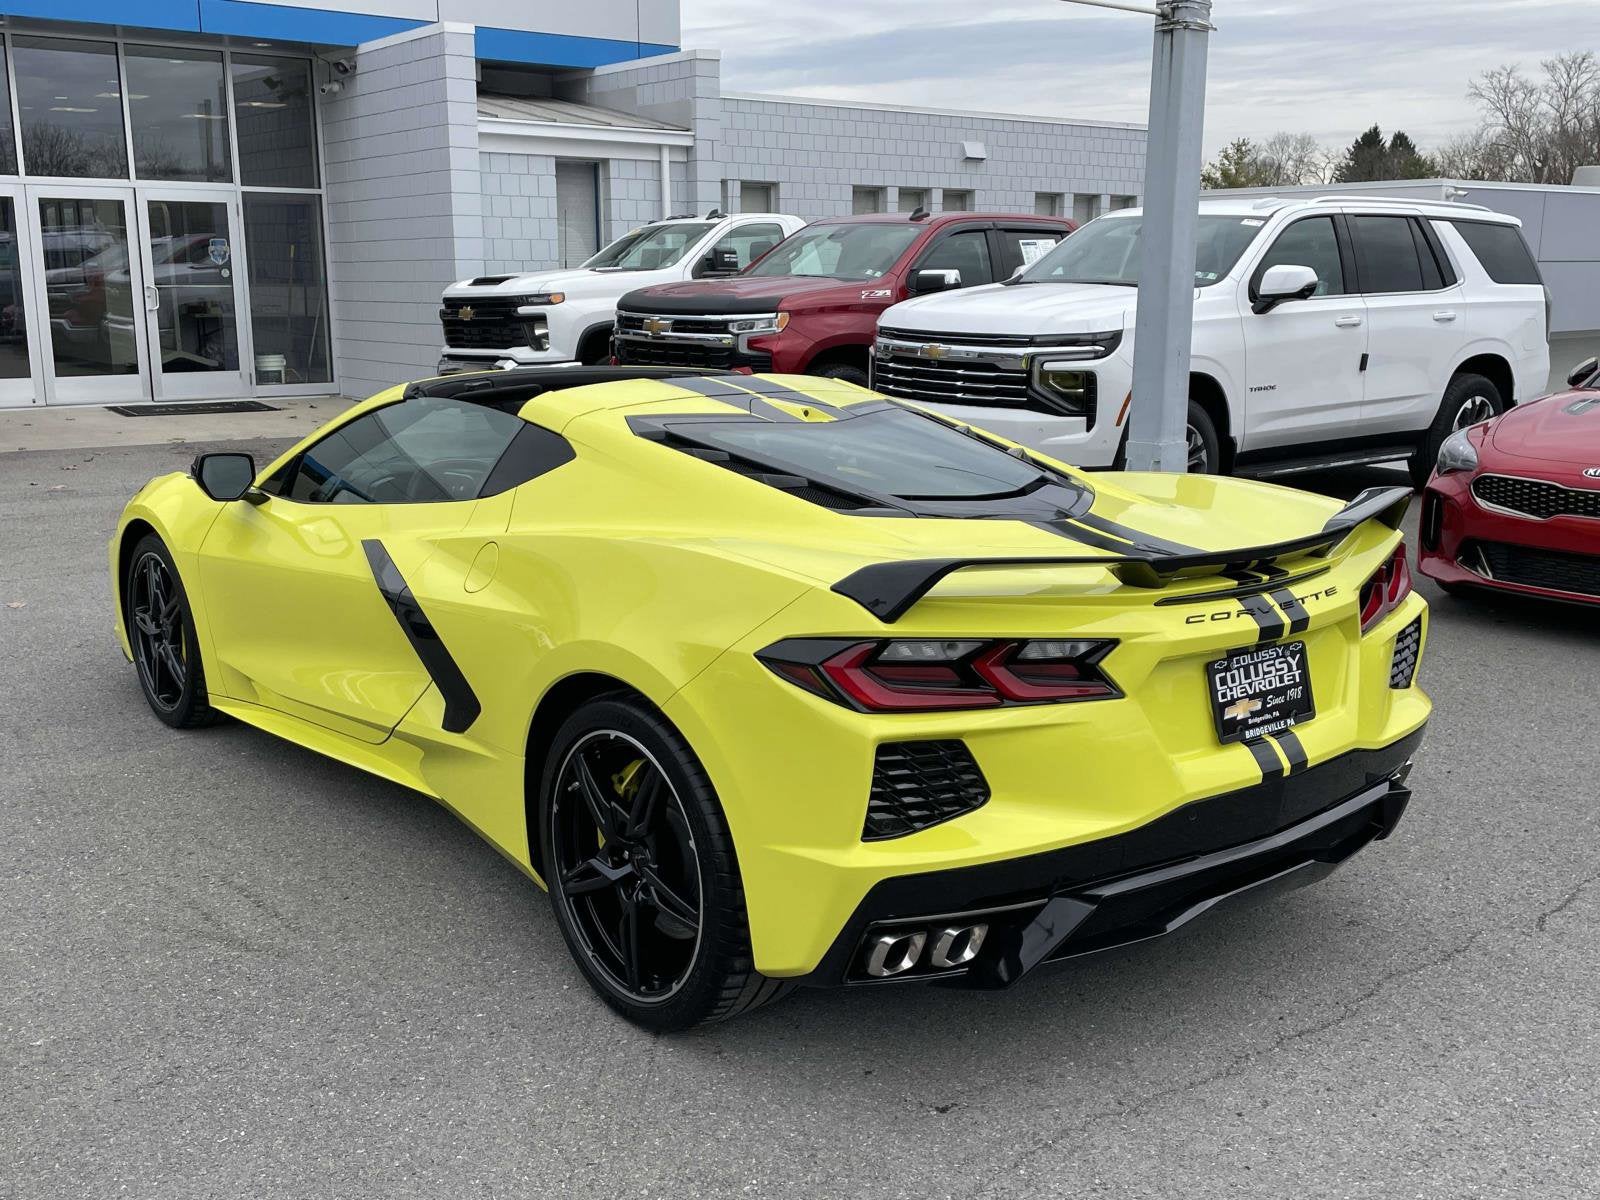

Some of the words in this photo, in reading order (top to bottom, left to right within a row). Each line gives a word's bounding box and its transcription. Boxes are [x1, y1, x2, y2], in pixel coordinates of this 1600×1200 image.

[1185, 586, 1338, 624] CORVETTE
[1233, 646, 1284, 667] COLUSSY
[1215, 654, 1300, 690] COLUSSY
[1217, 670, 1302, 702] CHEVROLET
[1266, 694, 1285, 708] Since
[1286, 686, 1303, 702] 1918
[1272, 710, 1280, 718] PA
[1287, 717, 1296, 729] PA
